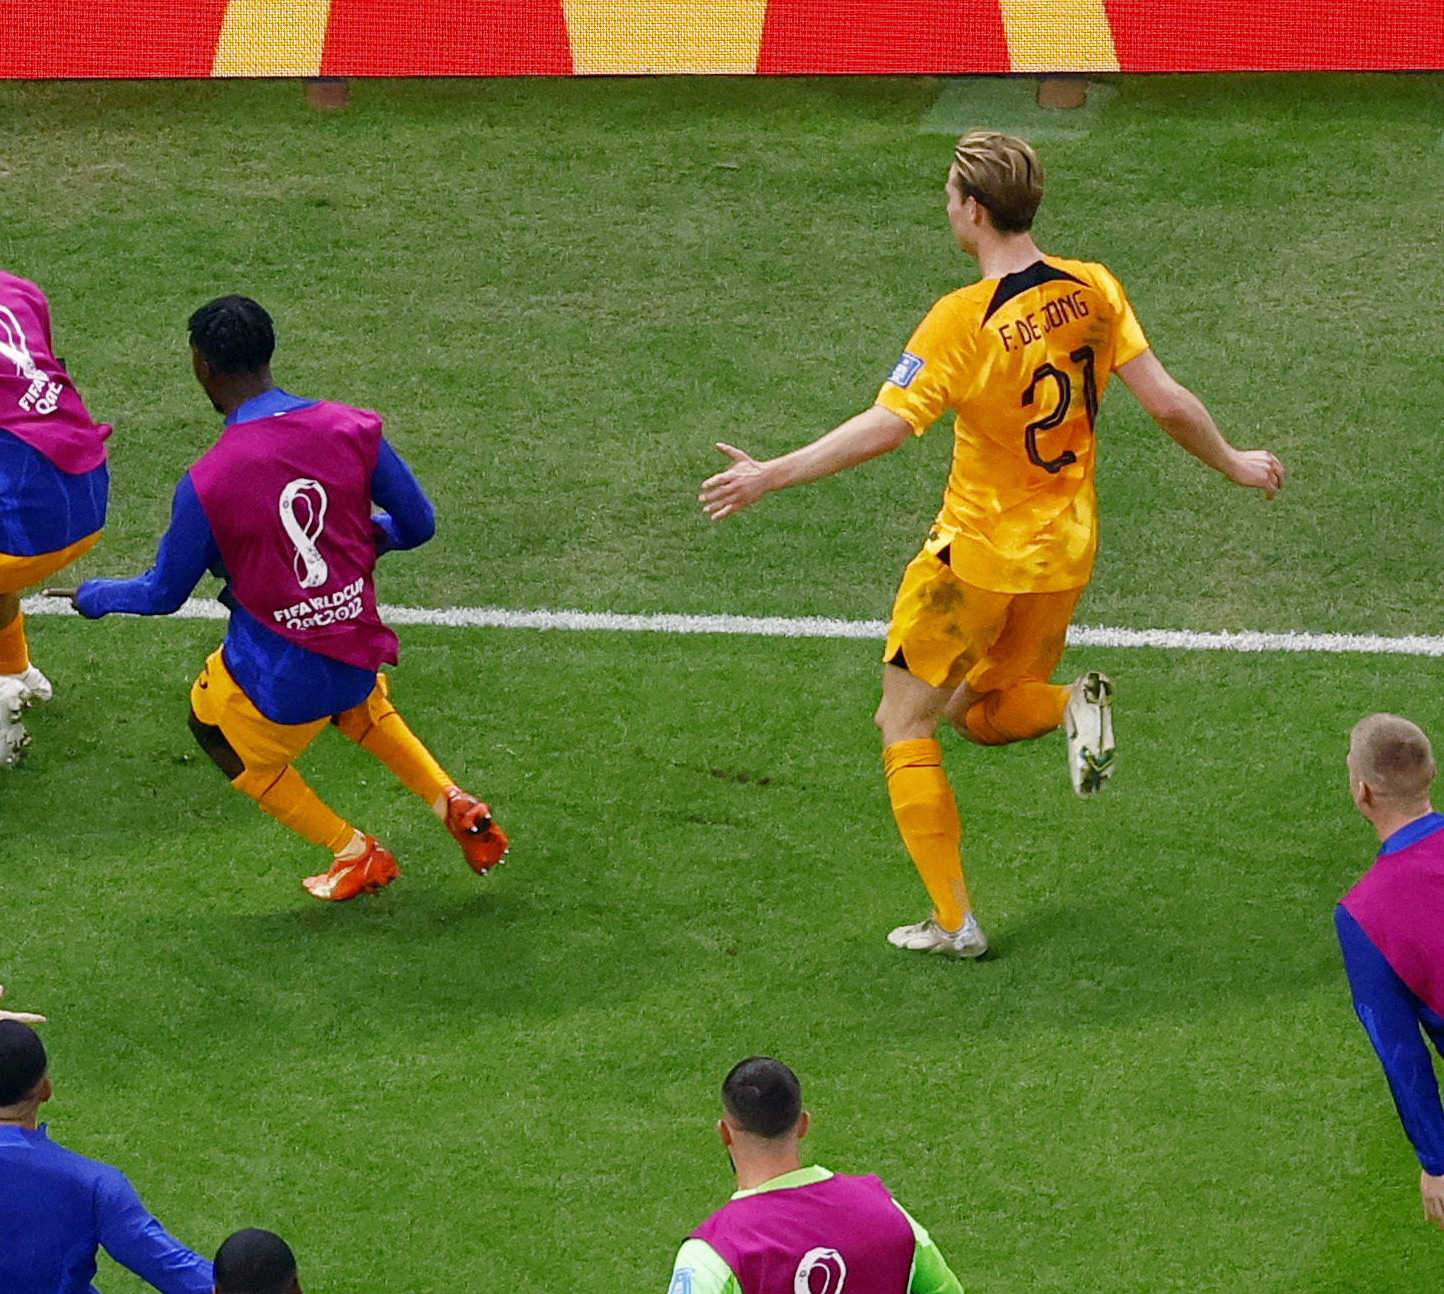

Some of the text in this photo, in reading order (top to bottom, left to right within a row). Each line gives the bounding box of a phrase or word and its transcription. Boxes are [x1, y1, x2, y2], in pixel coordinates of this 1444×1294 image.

[1014, 312, 1042, 346] DE
[1040, 290, 1089, 340] JONG
[1022, 345, 1097, 474] 21
[274, 599, 314, 622] FIFA
[340, 577, 365, 606] CUP
